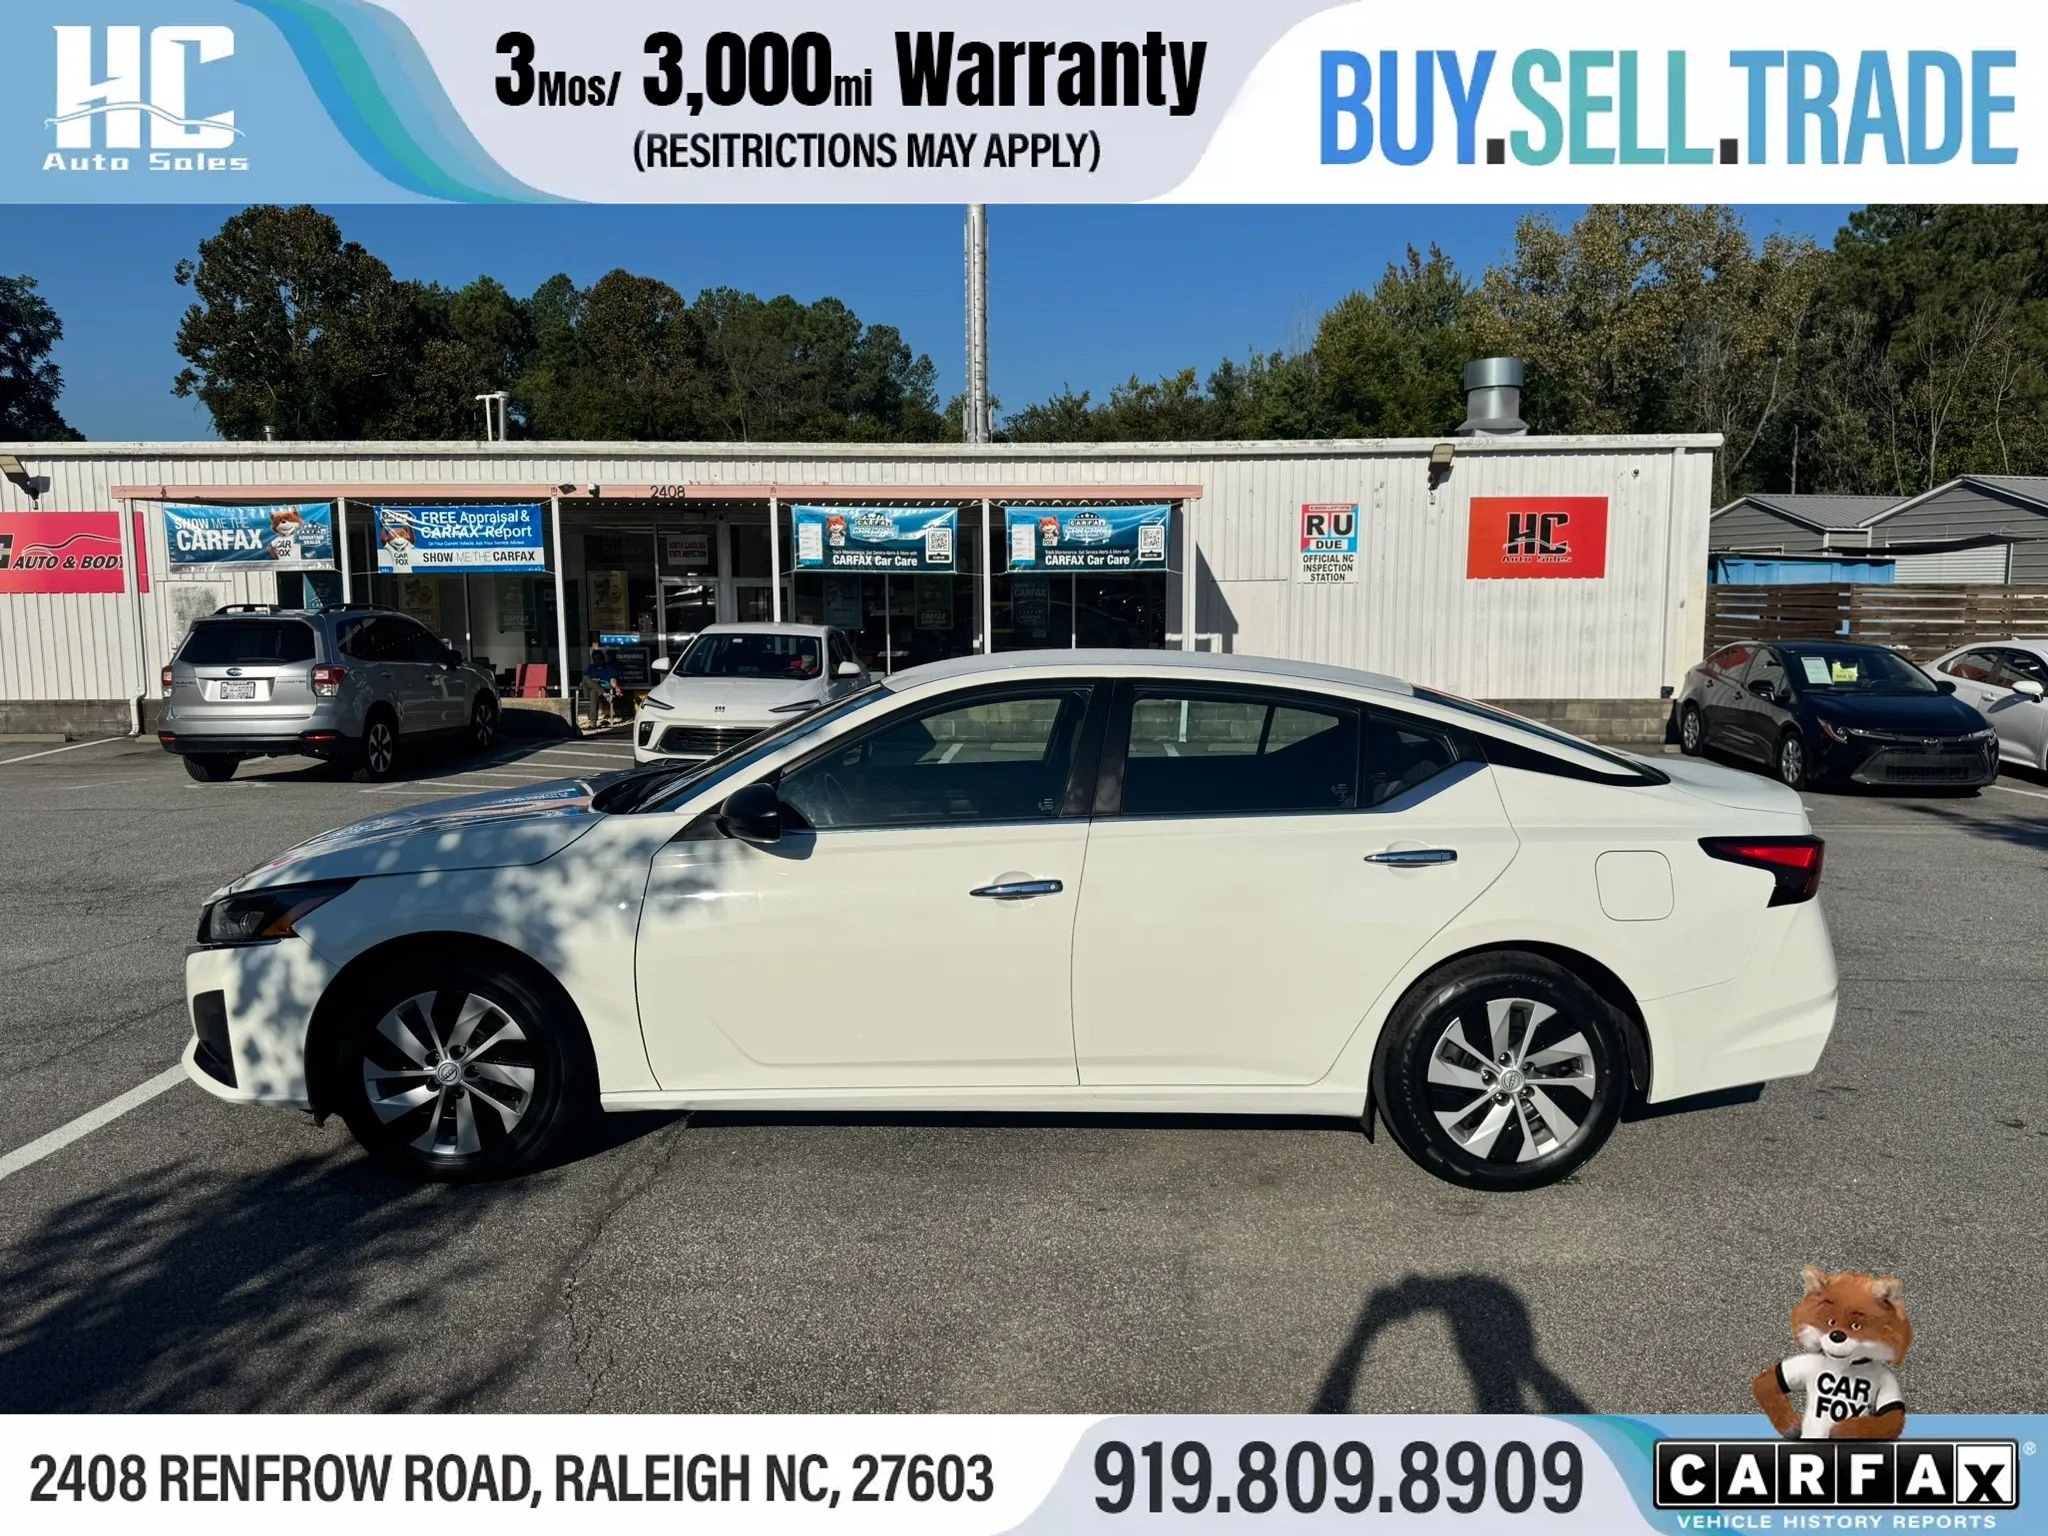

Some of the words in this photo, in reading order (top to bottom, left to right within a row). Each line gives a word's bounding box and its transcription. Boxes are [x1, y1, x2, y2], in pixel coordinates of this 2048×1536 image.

[650, 485, 685, 498] 2408
[175, 517, 208, 530] SHOW
[213, 518, 227, 529] ME
[231, 517, 250, 529] THE
[421, 511, 456, 524] FREE
[460, 509, 519, 527] Appraisal
[520, 511, 530, 523] &
[1306, 514, 1325, 536] R
[1333, 514, 1353, 536] U
[421, 525, 480, 539] CARFAX
[486, 525, 532, 540] Report
[1505, 512, 1570, 555] HC
[176, 528, 263, 551] CARFAX
[1316, 540, 1342, 549] DUE
[13, 555, 59, 569] AUTO
[62, 555, 76, 569] &
[423, 552, 453, 563] SHOW
[456, 552, 472, 563] ME
[474, 551, 491, 562] THE
[493, 551, 535, 562] CARFAX
[833, 555, 872, 566] CARFAX
[875, 555, 892, 566] Car
[895, 555, 918, 567] Care
[1045, 554, 1084, 566] CARFAX
[1087, 555, 1104, 565] Car
[1107, 554, 1130, 565] Care
[1303, 554, 1340, 563] OFFICIAL
[1343, 554, 1354, 563] NC
[1303, 564, 1353, 572] INSPECTION
[1310, 573, 1345, 582] STATION
